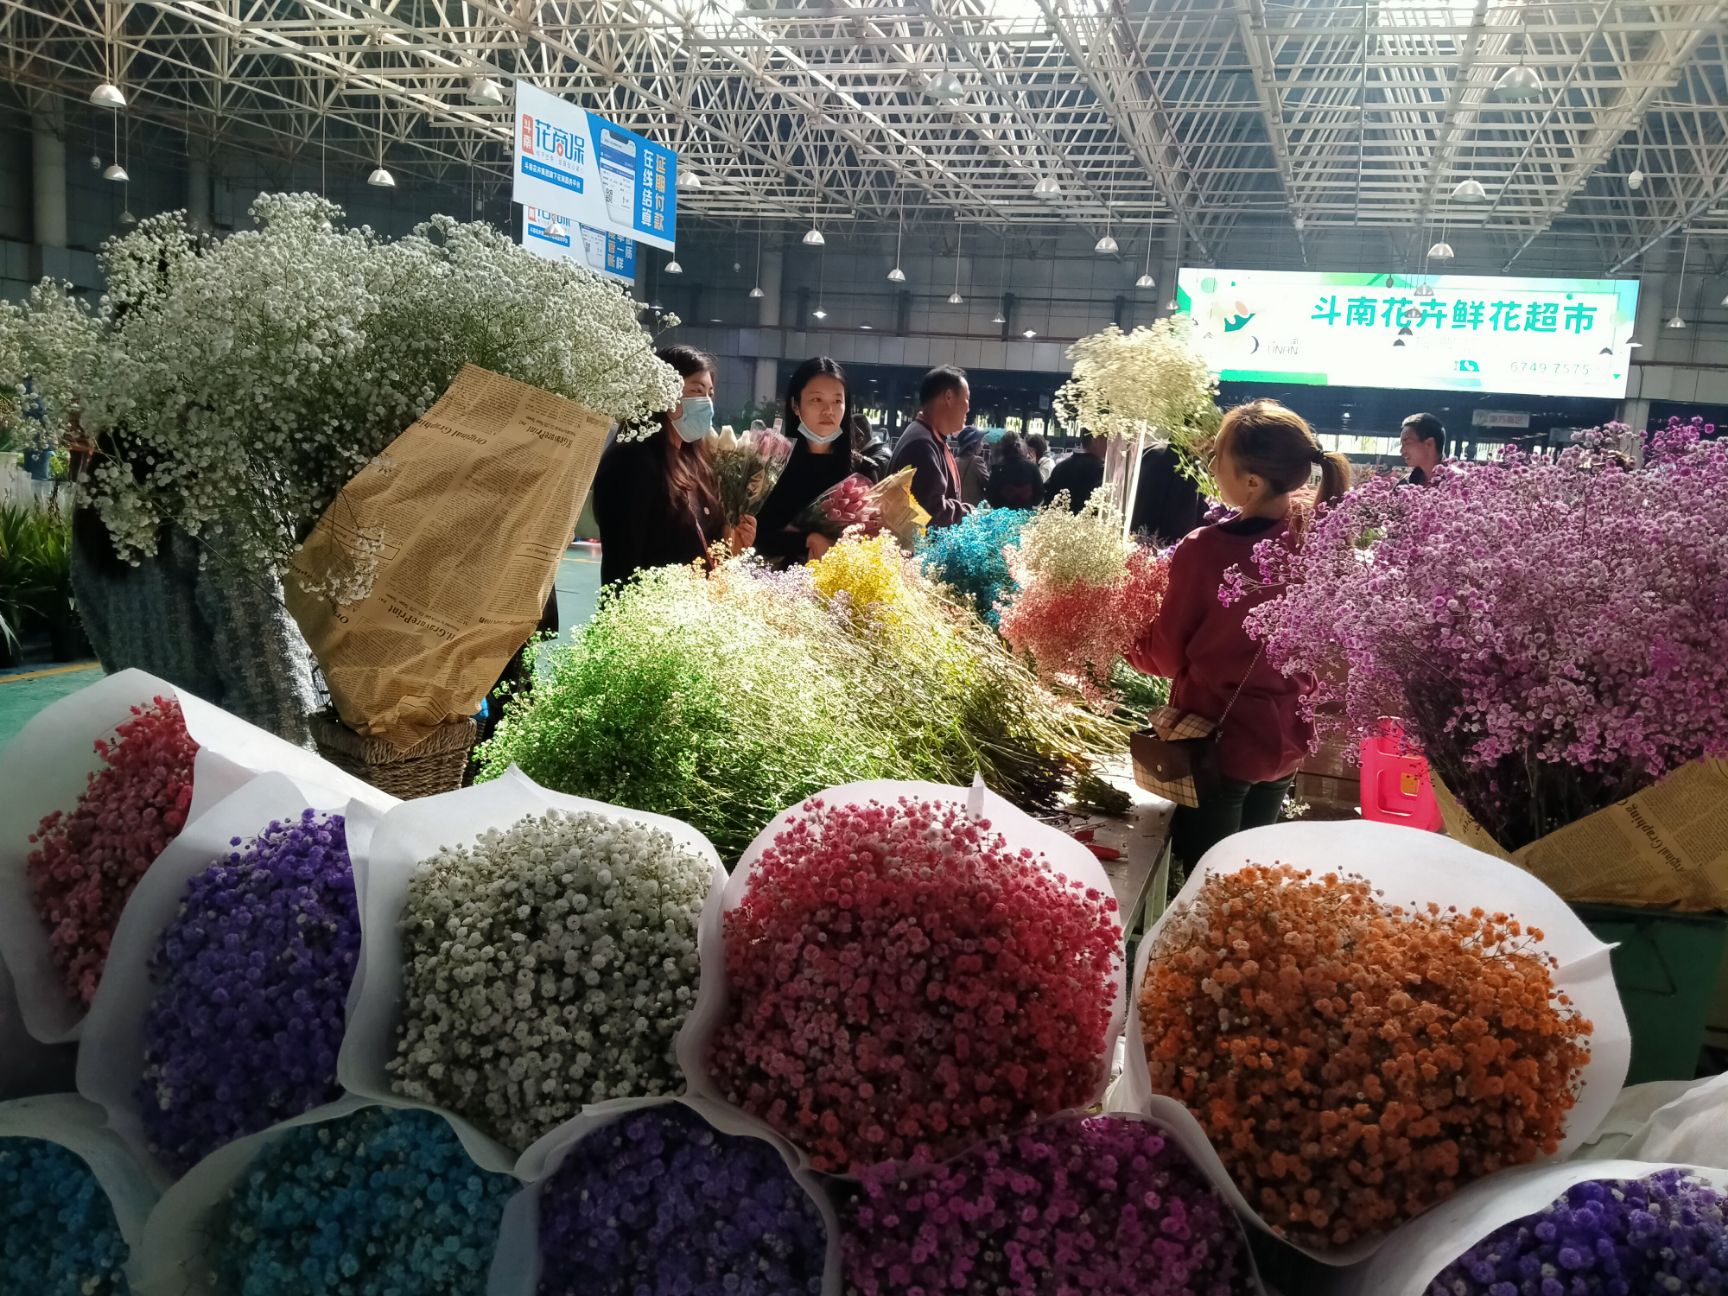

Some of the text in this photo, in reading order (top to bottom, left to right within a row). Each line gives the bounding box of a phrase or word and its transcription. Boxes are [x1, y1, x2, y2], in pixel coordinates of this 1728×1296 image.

[641, 149, 653, 226] 在线结算
[1311, 295, 1597, 334] 斗南花卉鲜花超市
[1510, 361, 1590, 376] 6749 7575
[450, 430, 488, 446] Original
[1625, 803, 1663, 850] Graphing
